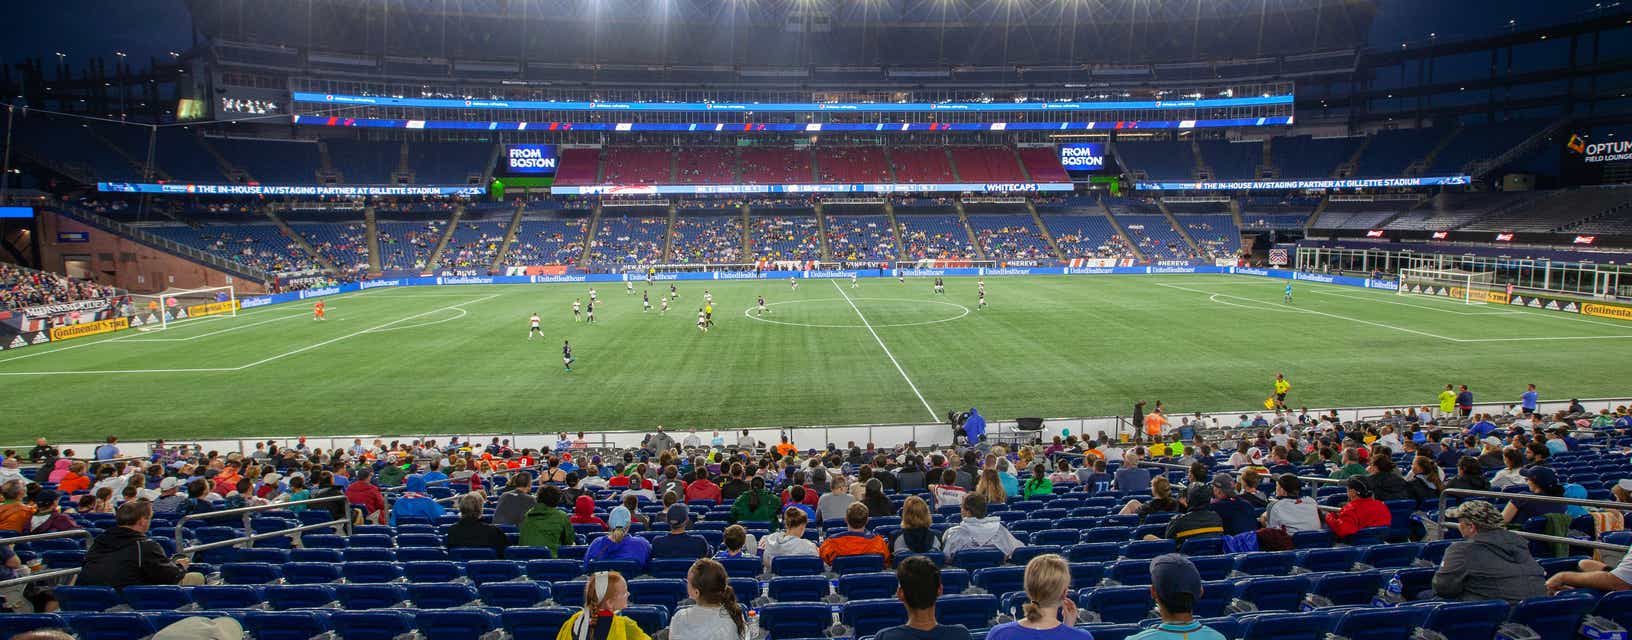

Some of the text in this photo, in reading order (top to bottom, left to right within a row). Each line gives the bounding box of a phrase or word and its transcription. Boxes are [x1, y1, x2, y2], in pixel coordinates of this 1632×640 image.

[1062, 147, 1091, 156] FROM
[1586, 141, 1632, 155] OPTUM
[510, 149, 541, 158] FROM
[510, 158, 555, 167] BOSTON
[1062, 156, 1102, 166] BOSTON
[1346, 179, 1383, 187] GILLETTE
[1384, 178, 1420, 186] STADIUM
[198, 185, 216, 193] THE
[218, 185, 262, 194] IN-HOUSE
[263, 186, 316, 194] AV/STAGING
[317, 186, 356, 194] PARTNER
[357, 186, 368, 194] AT
[369, 186, 405, 194] GILLETTE
[407, 186, 441, 194] STADIUM
[986, 183, 1036, 192] WHITECAPS
[54, 322, 102, 339] Continental
[666, 481, 676, 492] 2
[1095, 481, 1109, 494] 77
